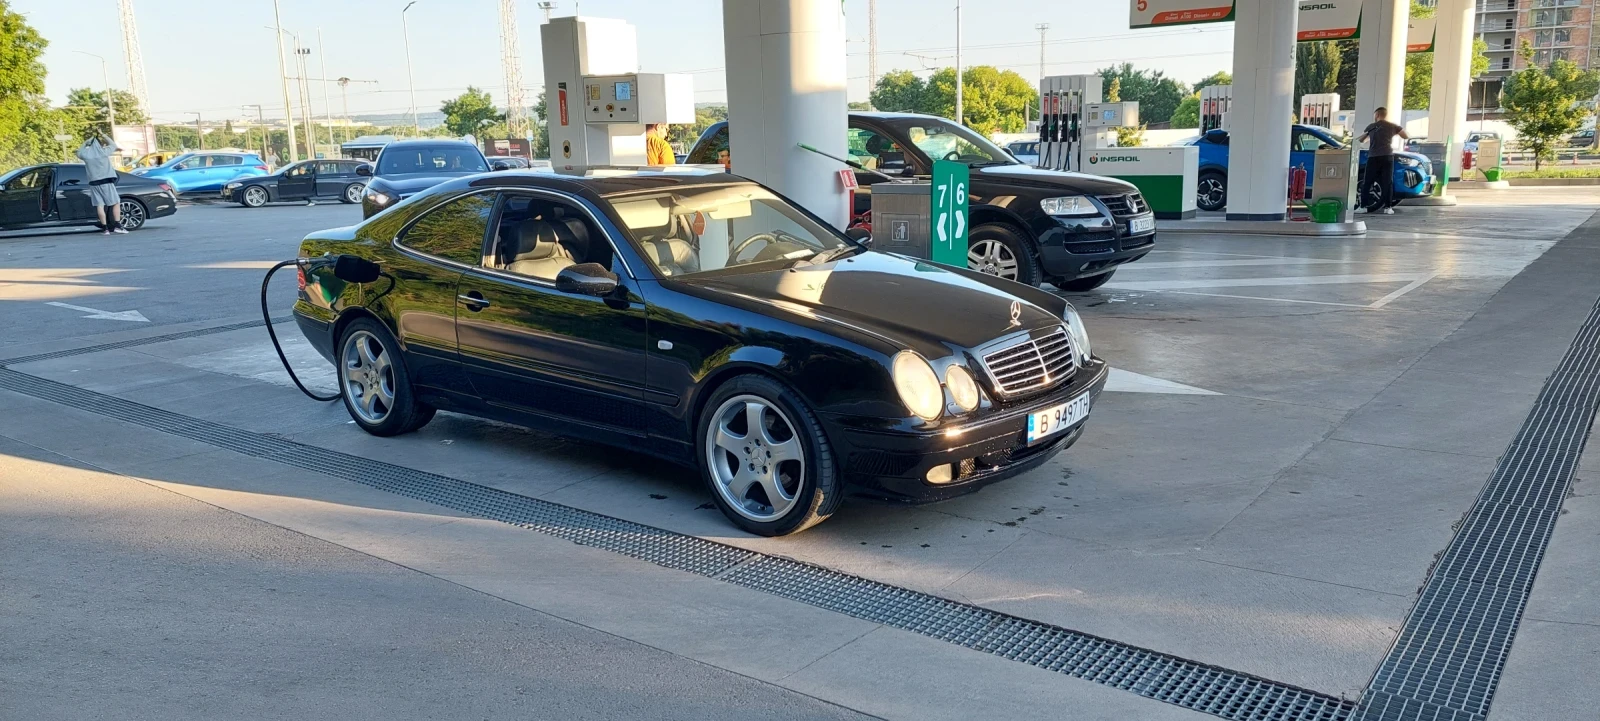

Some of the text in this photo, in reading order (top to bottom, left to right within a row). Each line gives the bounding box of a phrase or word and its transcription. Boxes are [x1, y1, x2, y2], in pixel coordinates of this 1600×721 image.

[1137, 0, 1148, 11] 5
[1299, 3, 1337, 11] NSAOIL
[938, 182, 965, 208] 7 6
[1041, 394, 1088, 434] B 9497 TH
